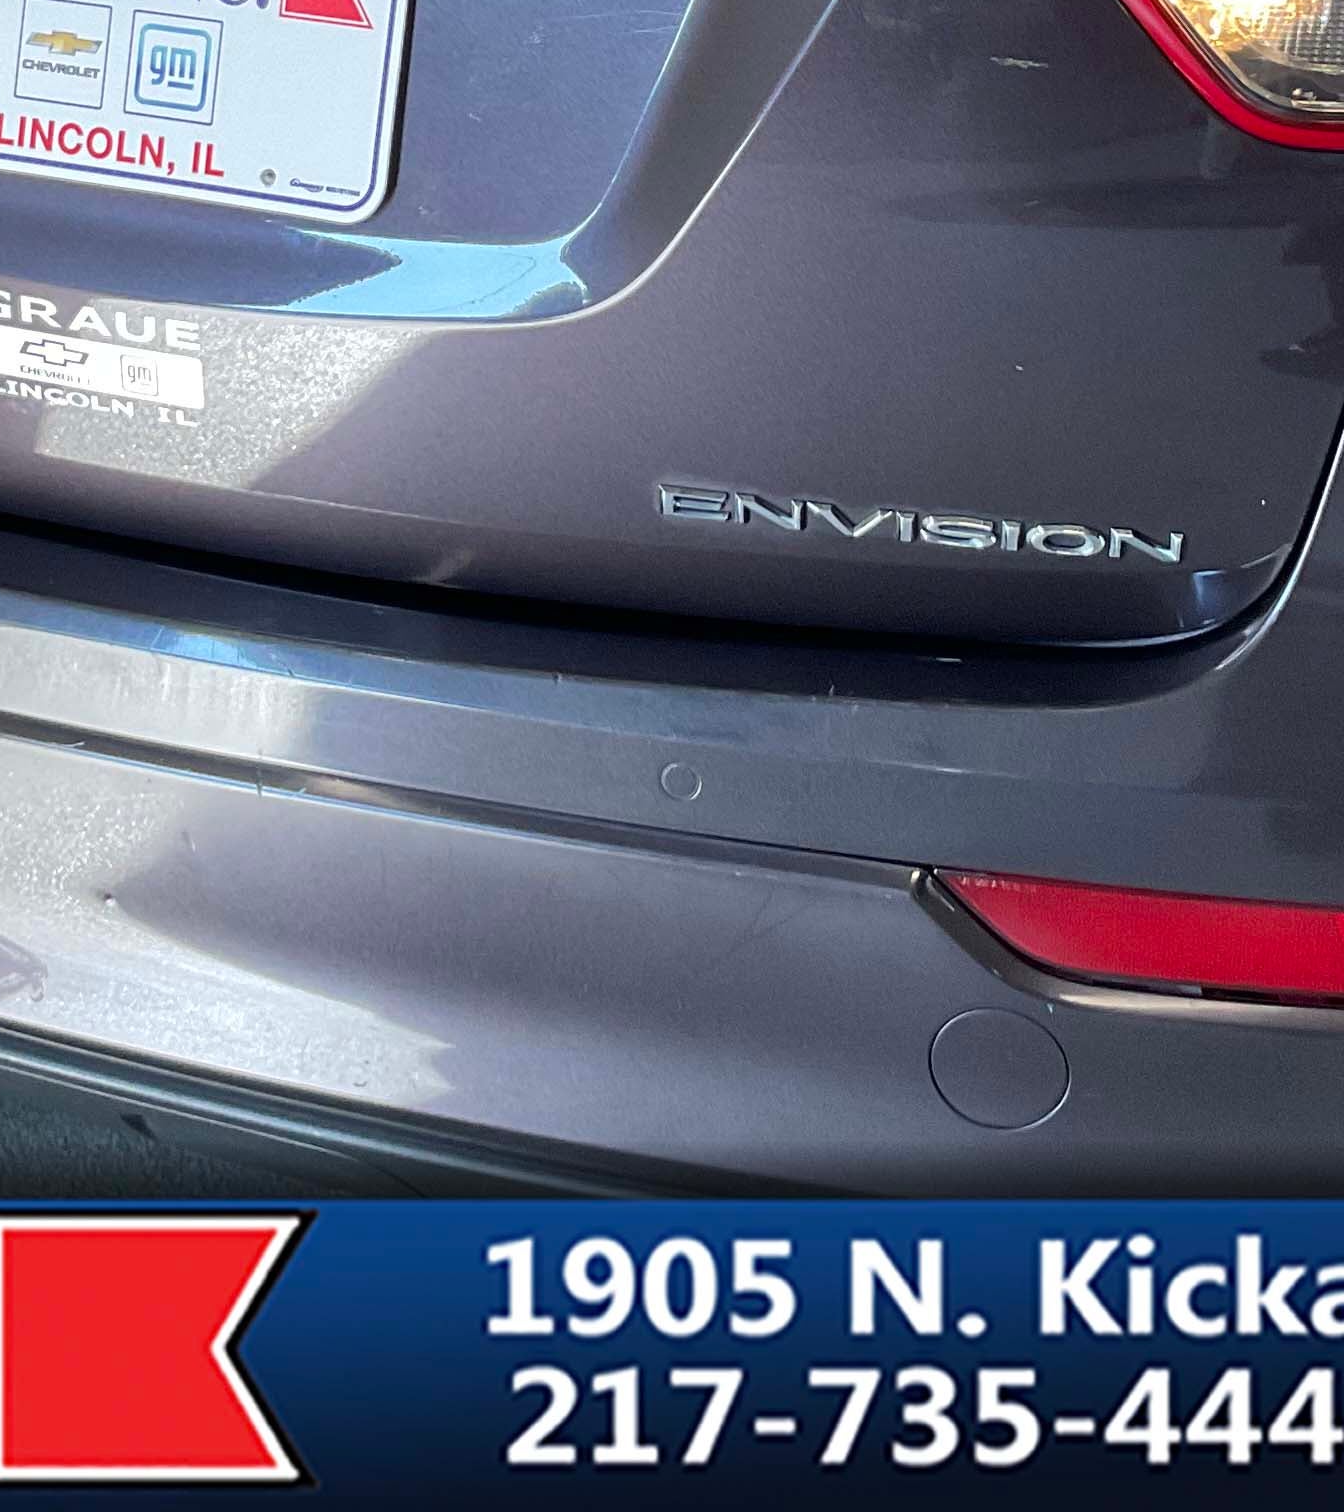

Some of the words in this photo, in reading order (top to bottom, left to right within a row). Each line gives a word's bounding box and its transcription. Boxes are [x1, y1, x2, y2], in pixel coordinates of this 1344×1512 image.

[22, 58, 101, 80] CHEVROLET
[149, 44, 198, 90] gm
[191, 142, 225, 178] IL
[158, 406, 200, 428] IL
[659, 484, 1185, 563] ENVISION
